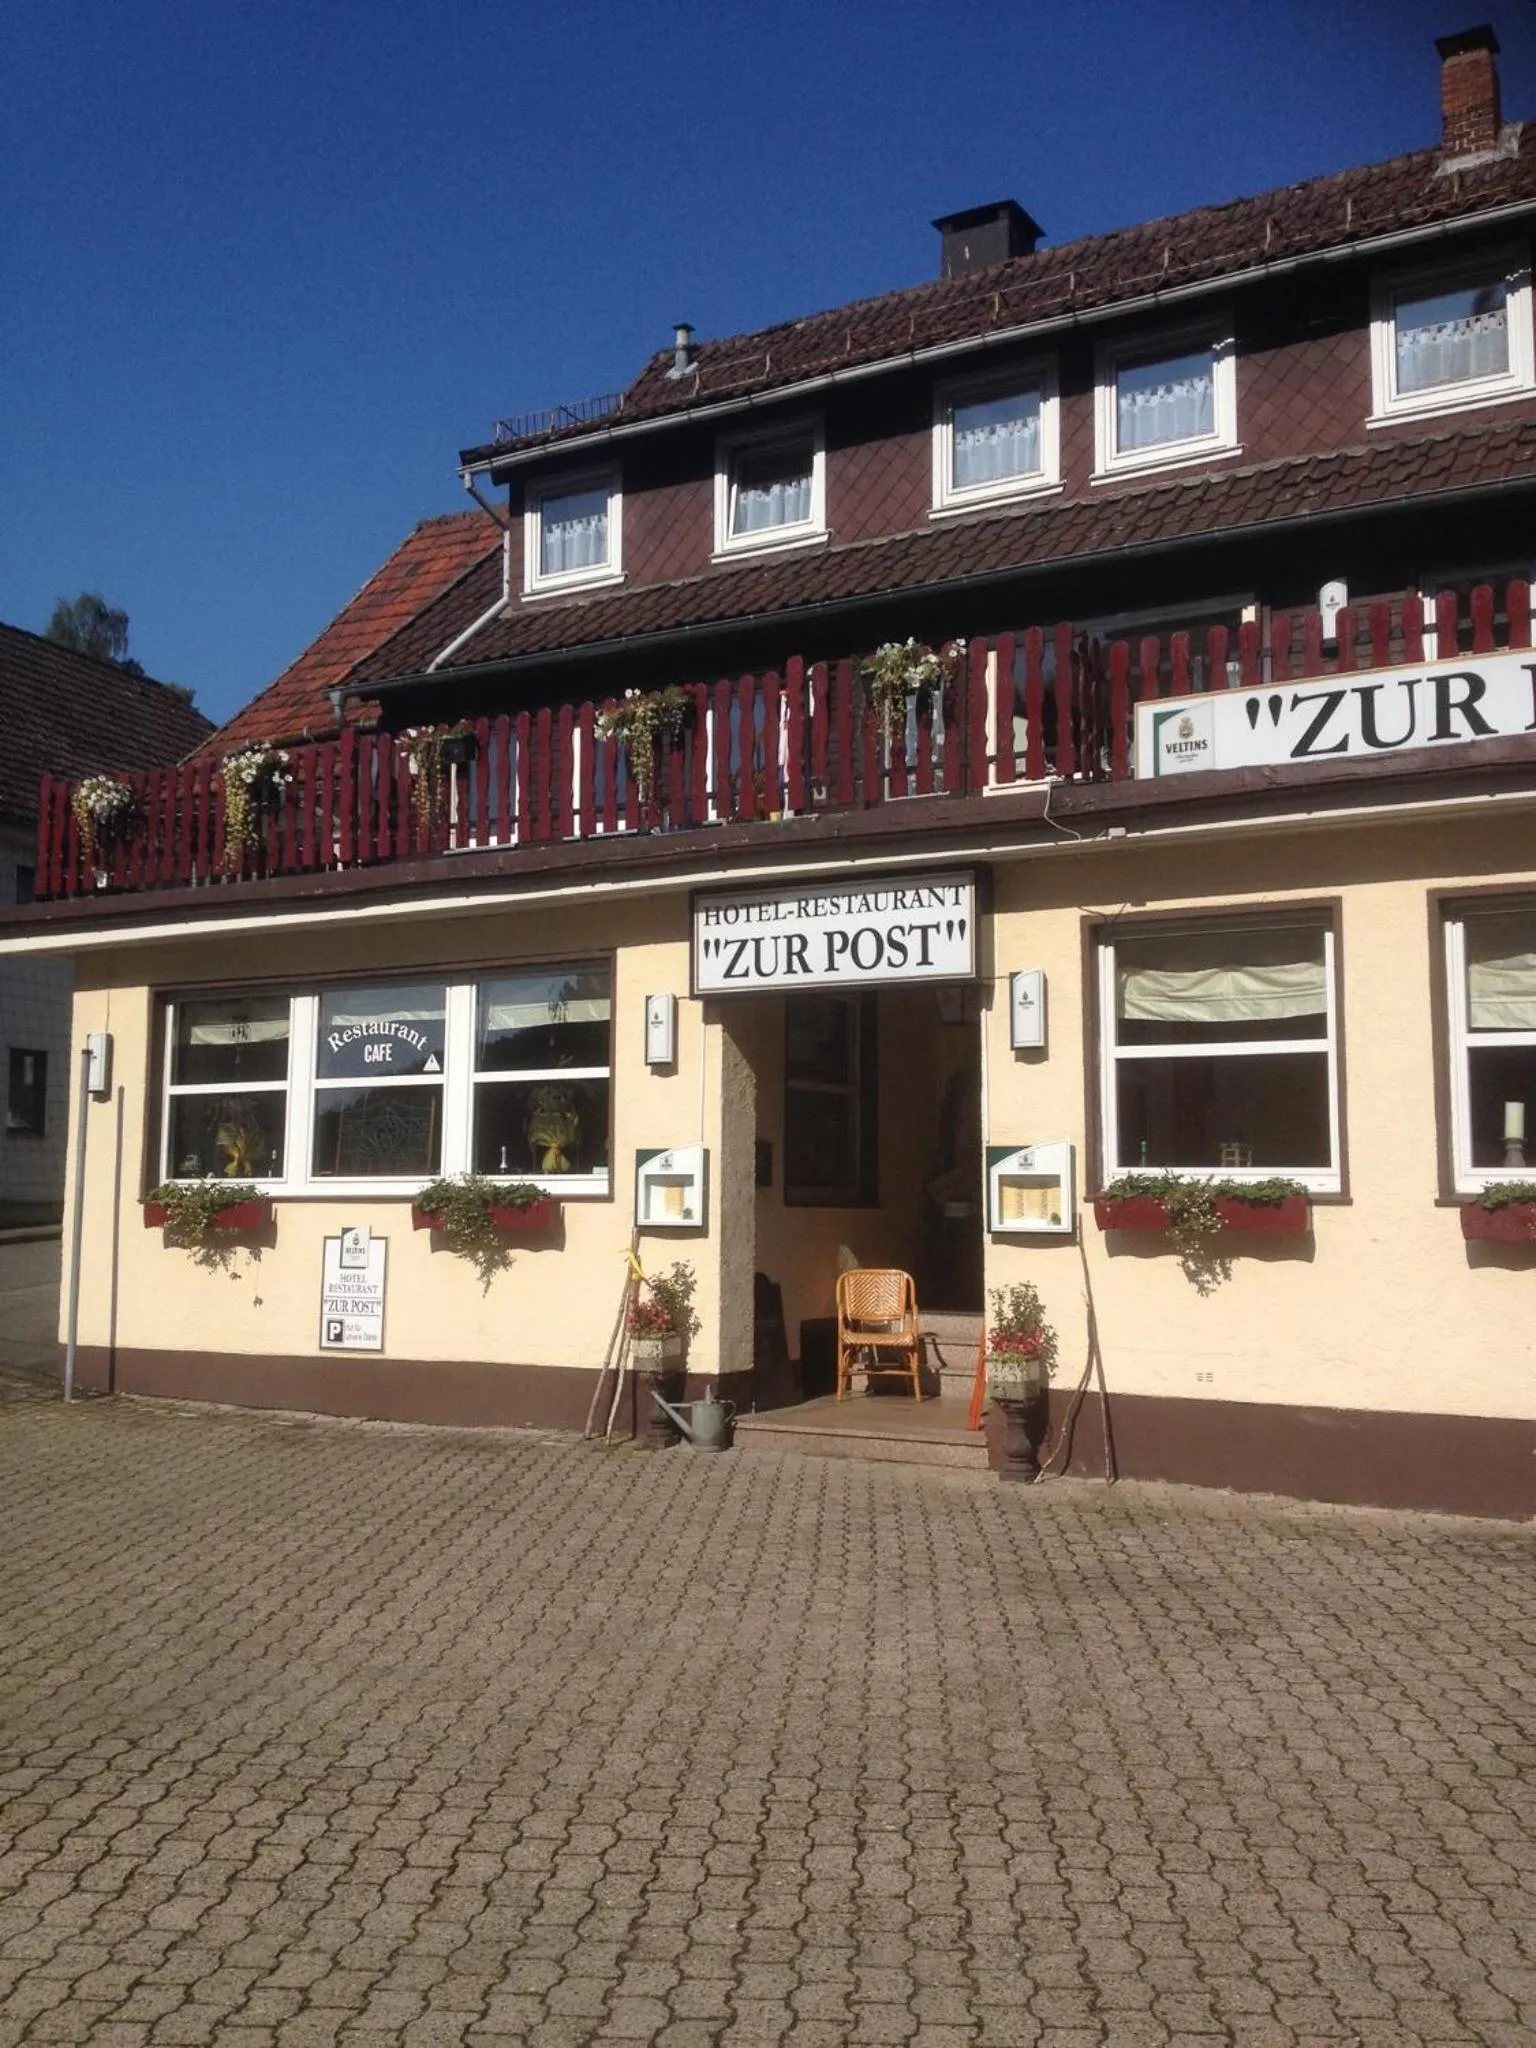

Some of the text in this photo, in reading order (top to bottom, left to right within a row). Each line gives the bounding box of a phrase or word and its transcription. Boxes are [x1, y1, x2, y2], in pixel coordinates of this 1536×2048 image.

[1245, 671, 1499, 758] "ZUR
[1165, 739, 1208, 754] VELTINS
[703, 884, 966, 927] HOTEL-RESTAURANT
[703, 918, 966, 979] "ZUR POST"
[328, 1020, 428, 1053] Restaurant
[364, 1042, 393, 1063] CAFE
[328, 1283, 379, 1295] RESTAURANT
[340, 1273, 367, 1284] HOTEL
[324, 1299, 381, 1314] "ZUR POST"
